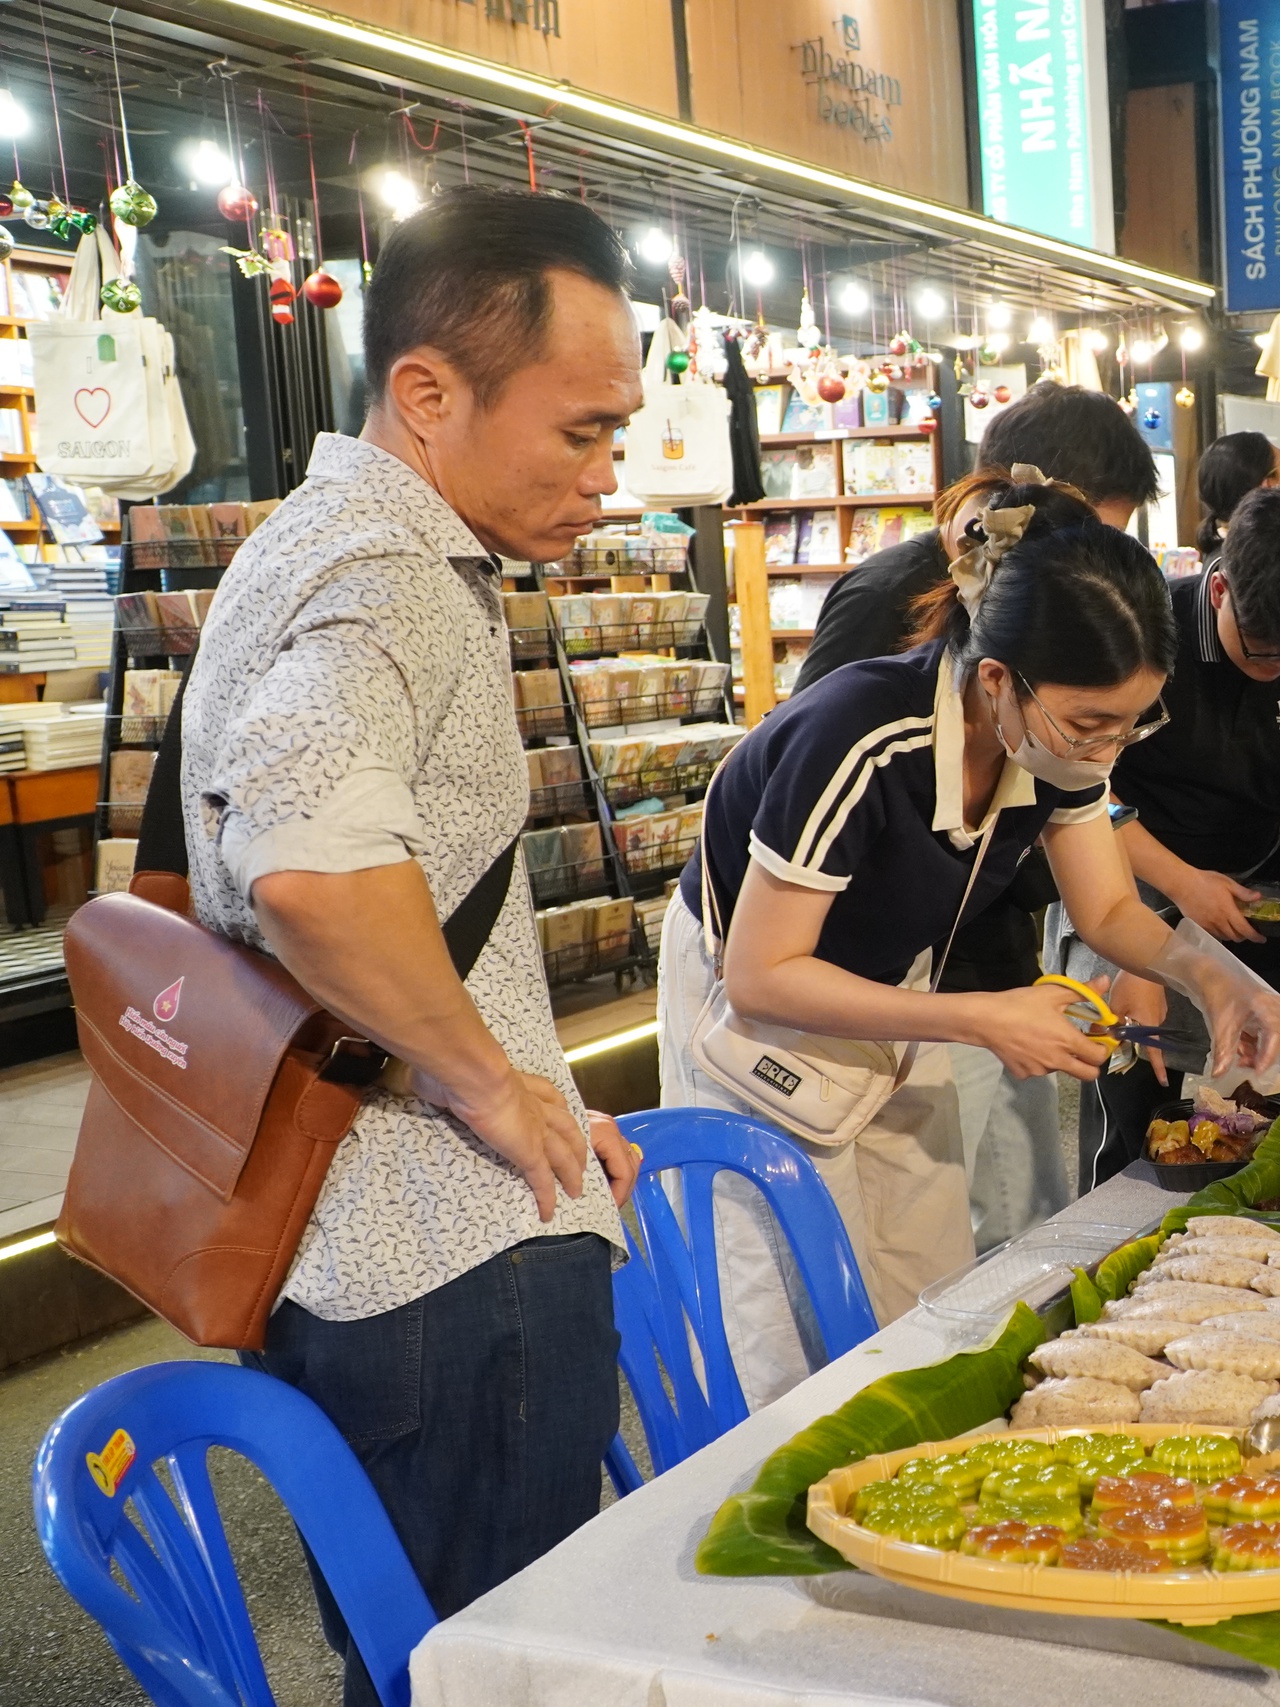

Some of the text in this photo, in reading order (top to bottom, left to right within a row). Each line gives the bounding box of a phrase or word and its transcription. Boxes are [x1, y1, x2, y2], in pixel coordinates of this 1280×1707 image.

[979, 10, 998, 49] HÓA
[1061, 0, 1076, 25] Co
[1061, 28, 1078, 61] and
[1008, 0, 1056, 153] NHÃ N
[1064, 64, 1082, 150] Publishing
[1238, 19, 1266, 280] SÁCH PHƯƠNG NAM
[1068, 152, 1083, 191] Nam
[58, 440, 131, 459] SAIGON
